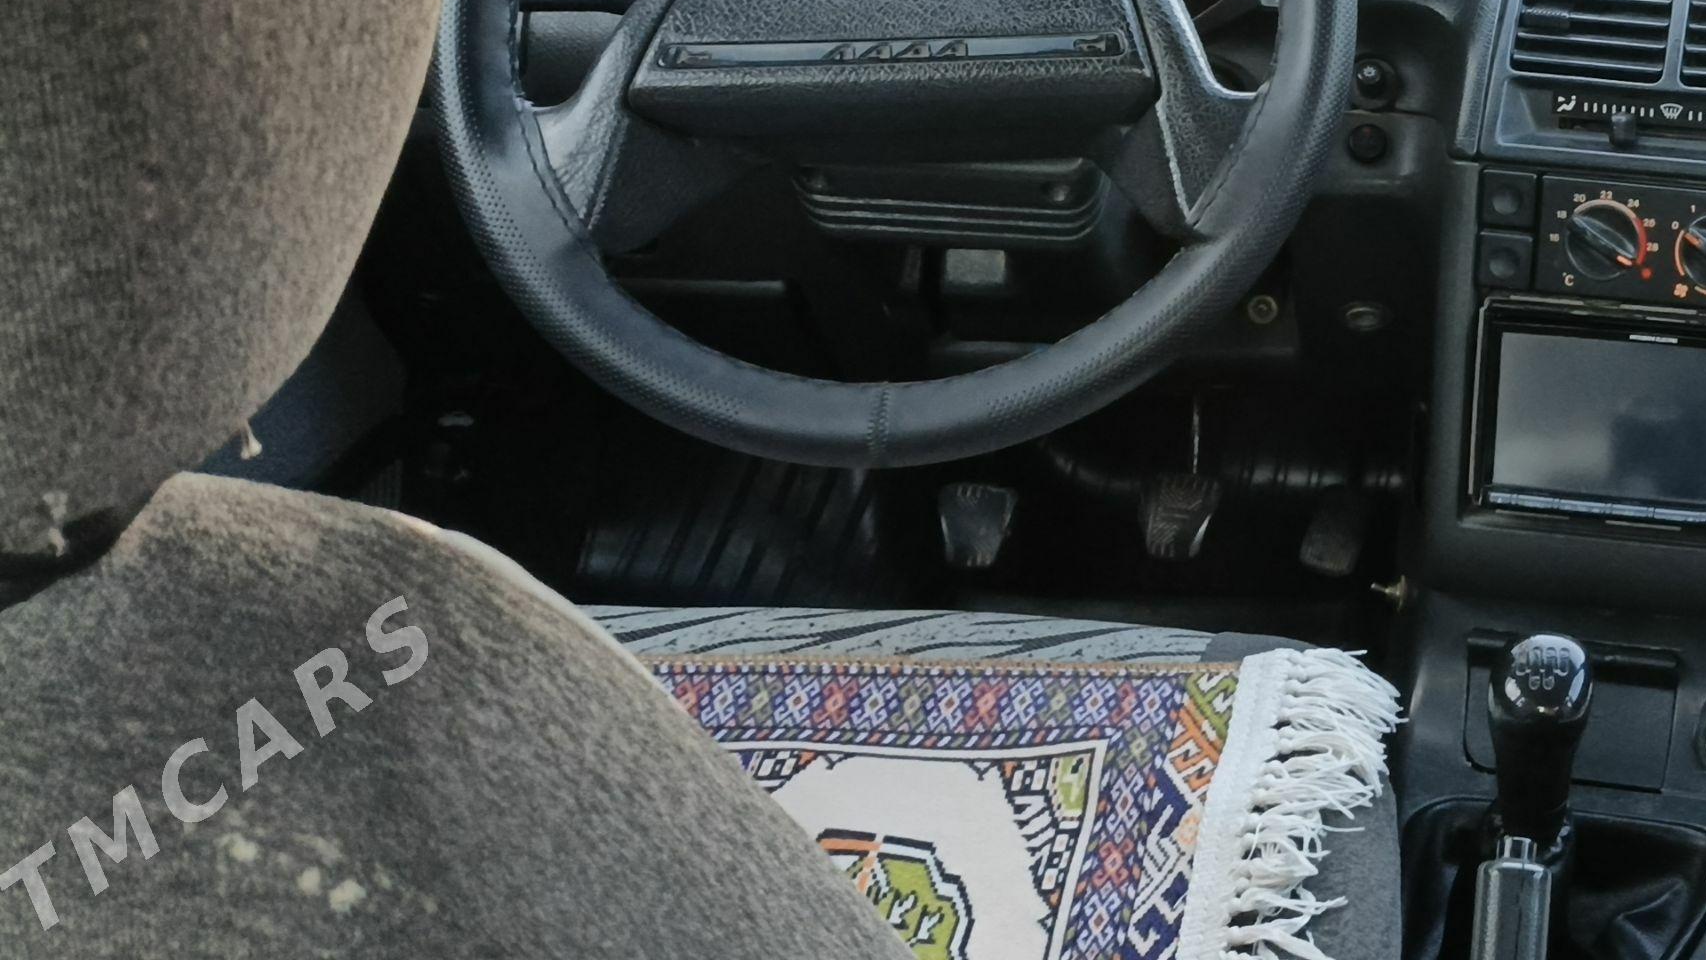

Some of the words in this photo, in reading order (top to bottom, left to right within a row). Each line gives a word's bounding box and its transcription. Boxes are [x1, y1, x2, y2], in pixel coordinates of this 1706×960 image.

[1573, 193, 1587, 202] 20
[1600, 190, 1613, 200] 22
[1627, 198, 1640, 208] 24
[1671, 221, 1680, 230] 0
[1646, 242, 1660, 252] 28
